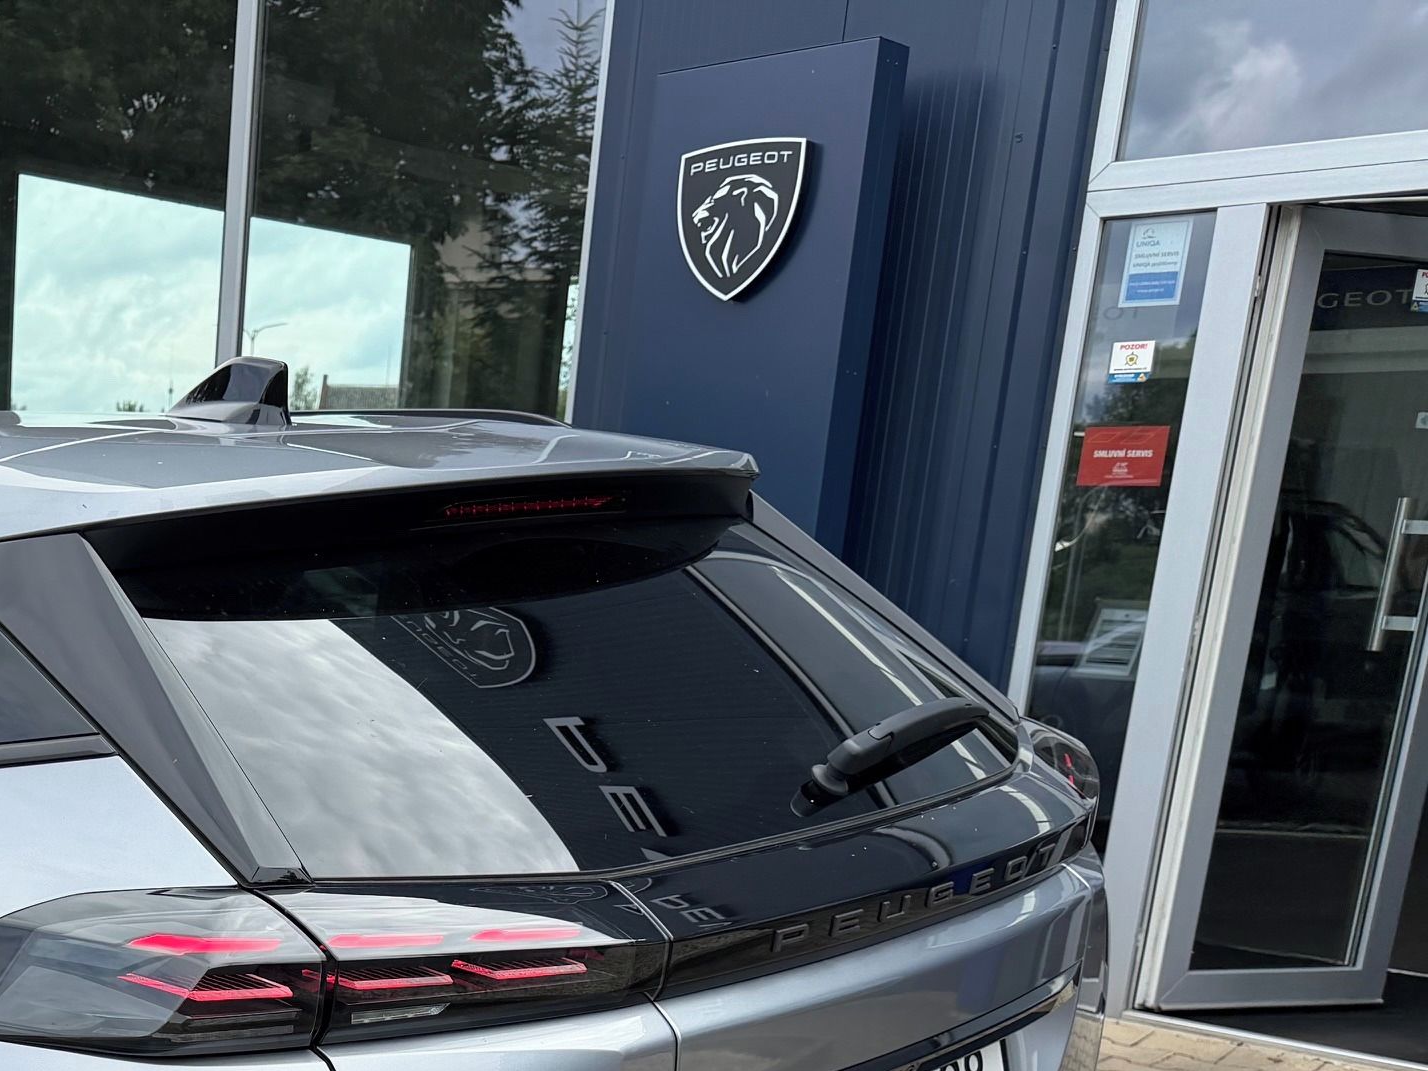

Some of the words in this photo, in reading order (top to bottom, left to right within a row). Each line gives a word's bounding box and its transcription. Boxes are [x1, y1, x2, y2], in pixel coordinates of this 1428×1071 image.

[690, 151, 793, 176] PEUGEOT
[1093, 448, 1126, 458] SMLUVNÍ
[1127, 449, 1154, 458] SERVIS
[772, 842, 1056, 951] PEUGEOT
